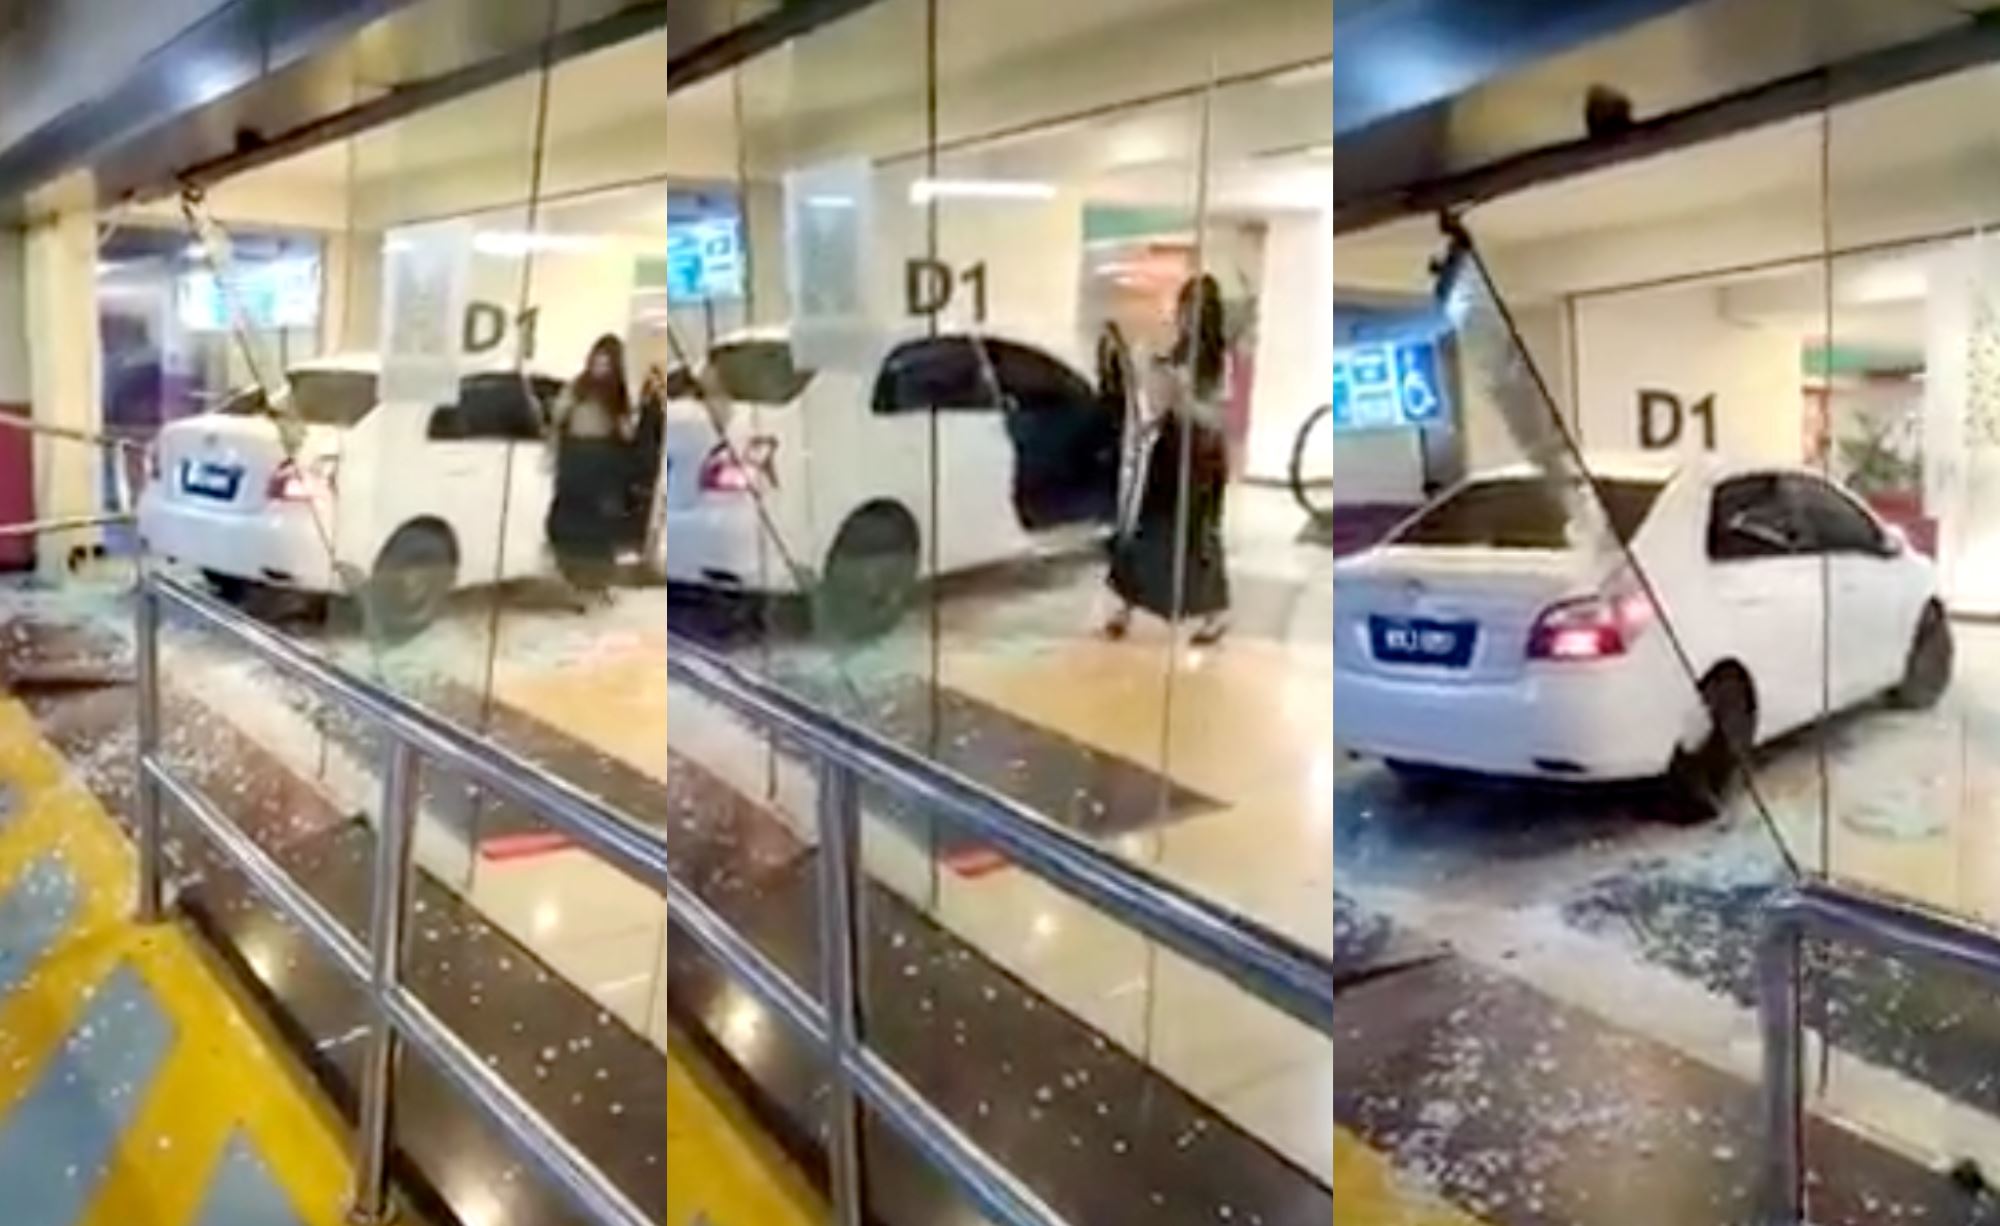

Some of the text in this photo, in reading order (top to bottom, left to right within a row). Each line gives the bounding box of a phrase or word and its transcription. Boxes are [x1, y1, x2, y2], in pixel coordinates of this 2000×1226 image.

[906, 259, 987, 323] D1
[462, 301, 540, 359] D1
[1638, 389, 1716, 451] D1
